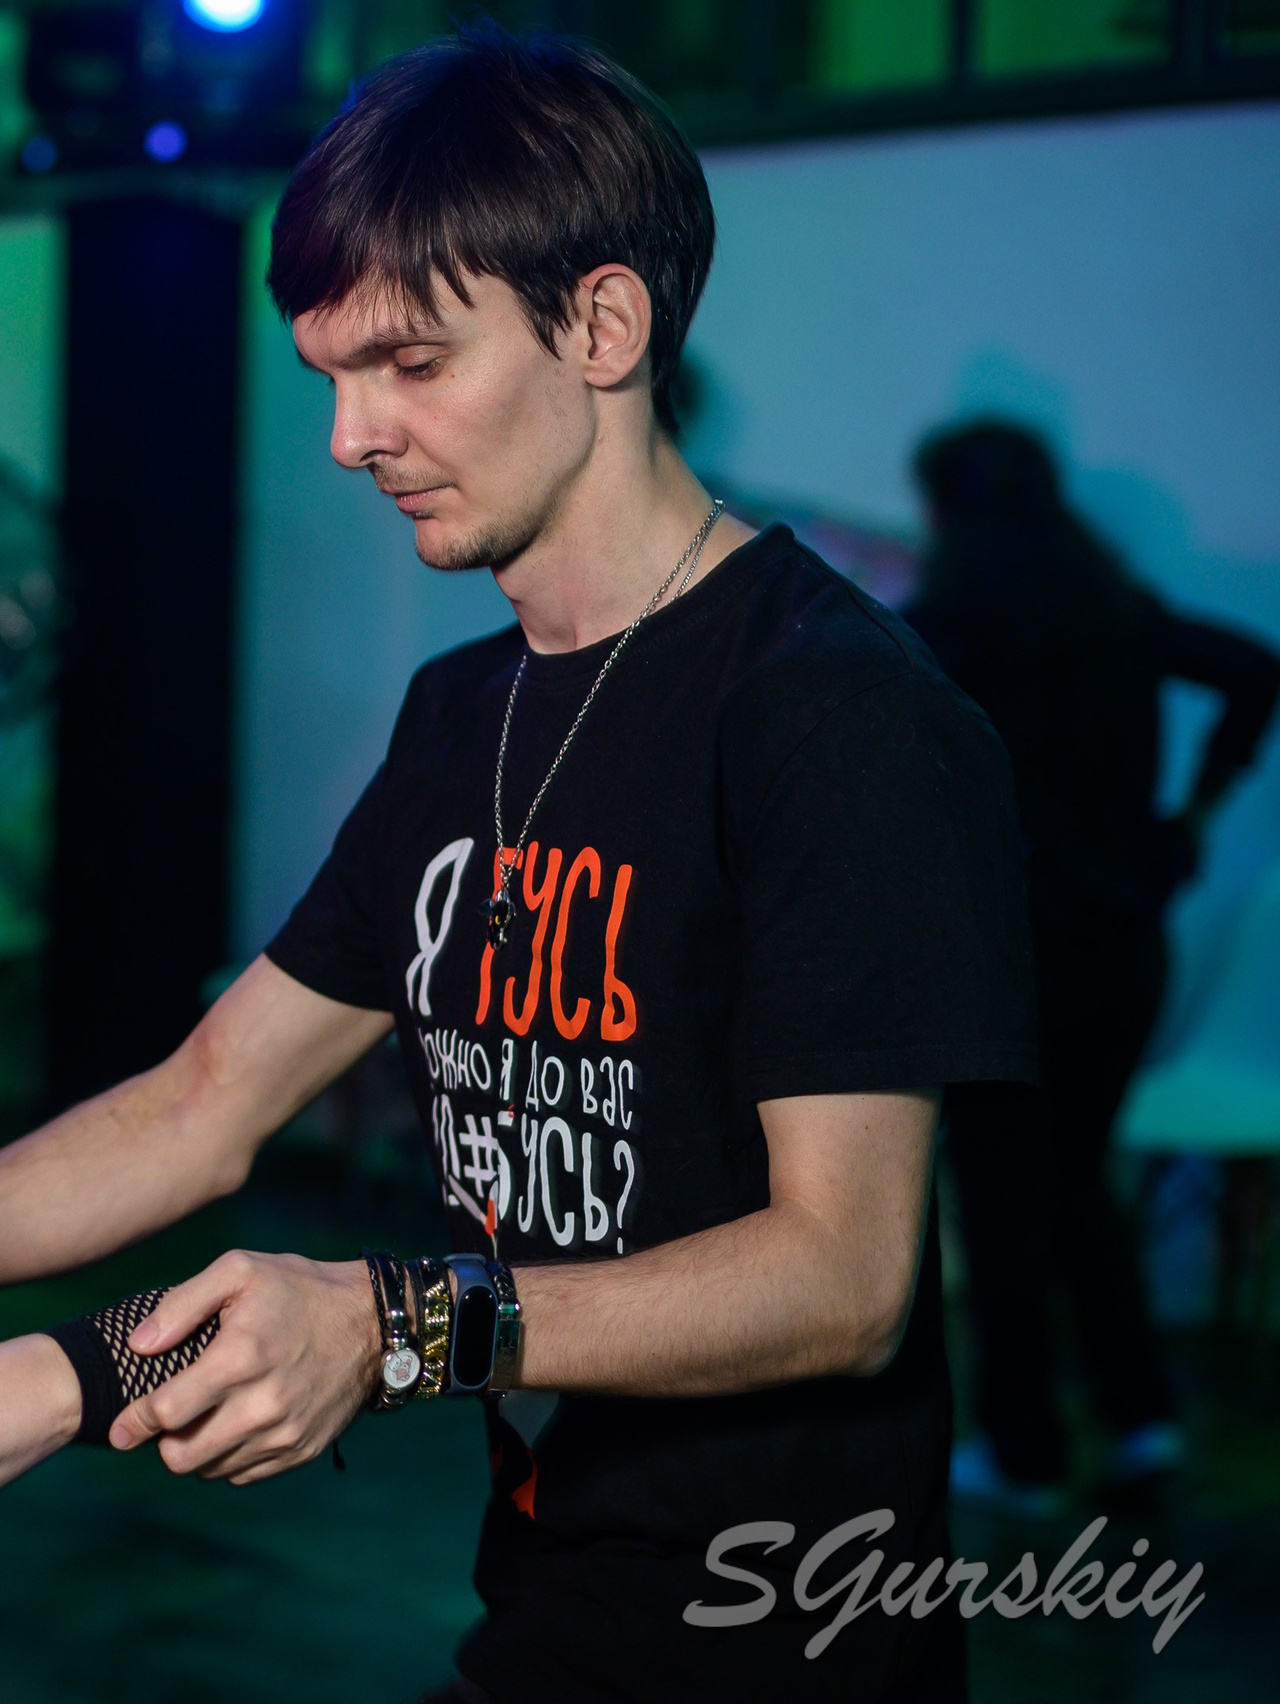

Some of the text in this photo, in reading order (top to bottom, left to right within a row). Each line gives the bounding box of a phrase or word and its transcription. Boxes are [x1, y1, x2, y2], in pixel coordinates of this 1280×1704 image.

[406, 837, 637, 1041] Я ГУСЬ
[500, 1038, 515, 1101] Я
[525, 1040, 565, 1113] ДО
